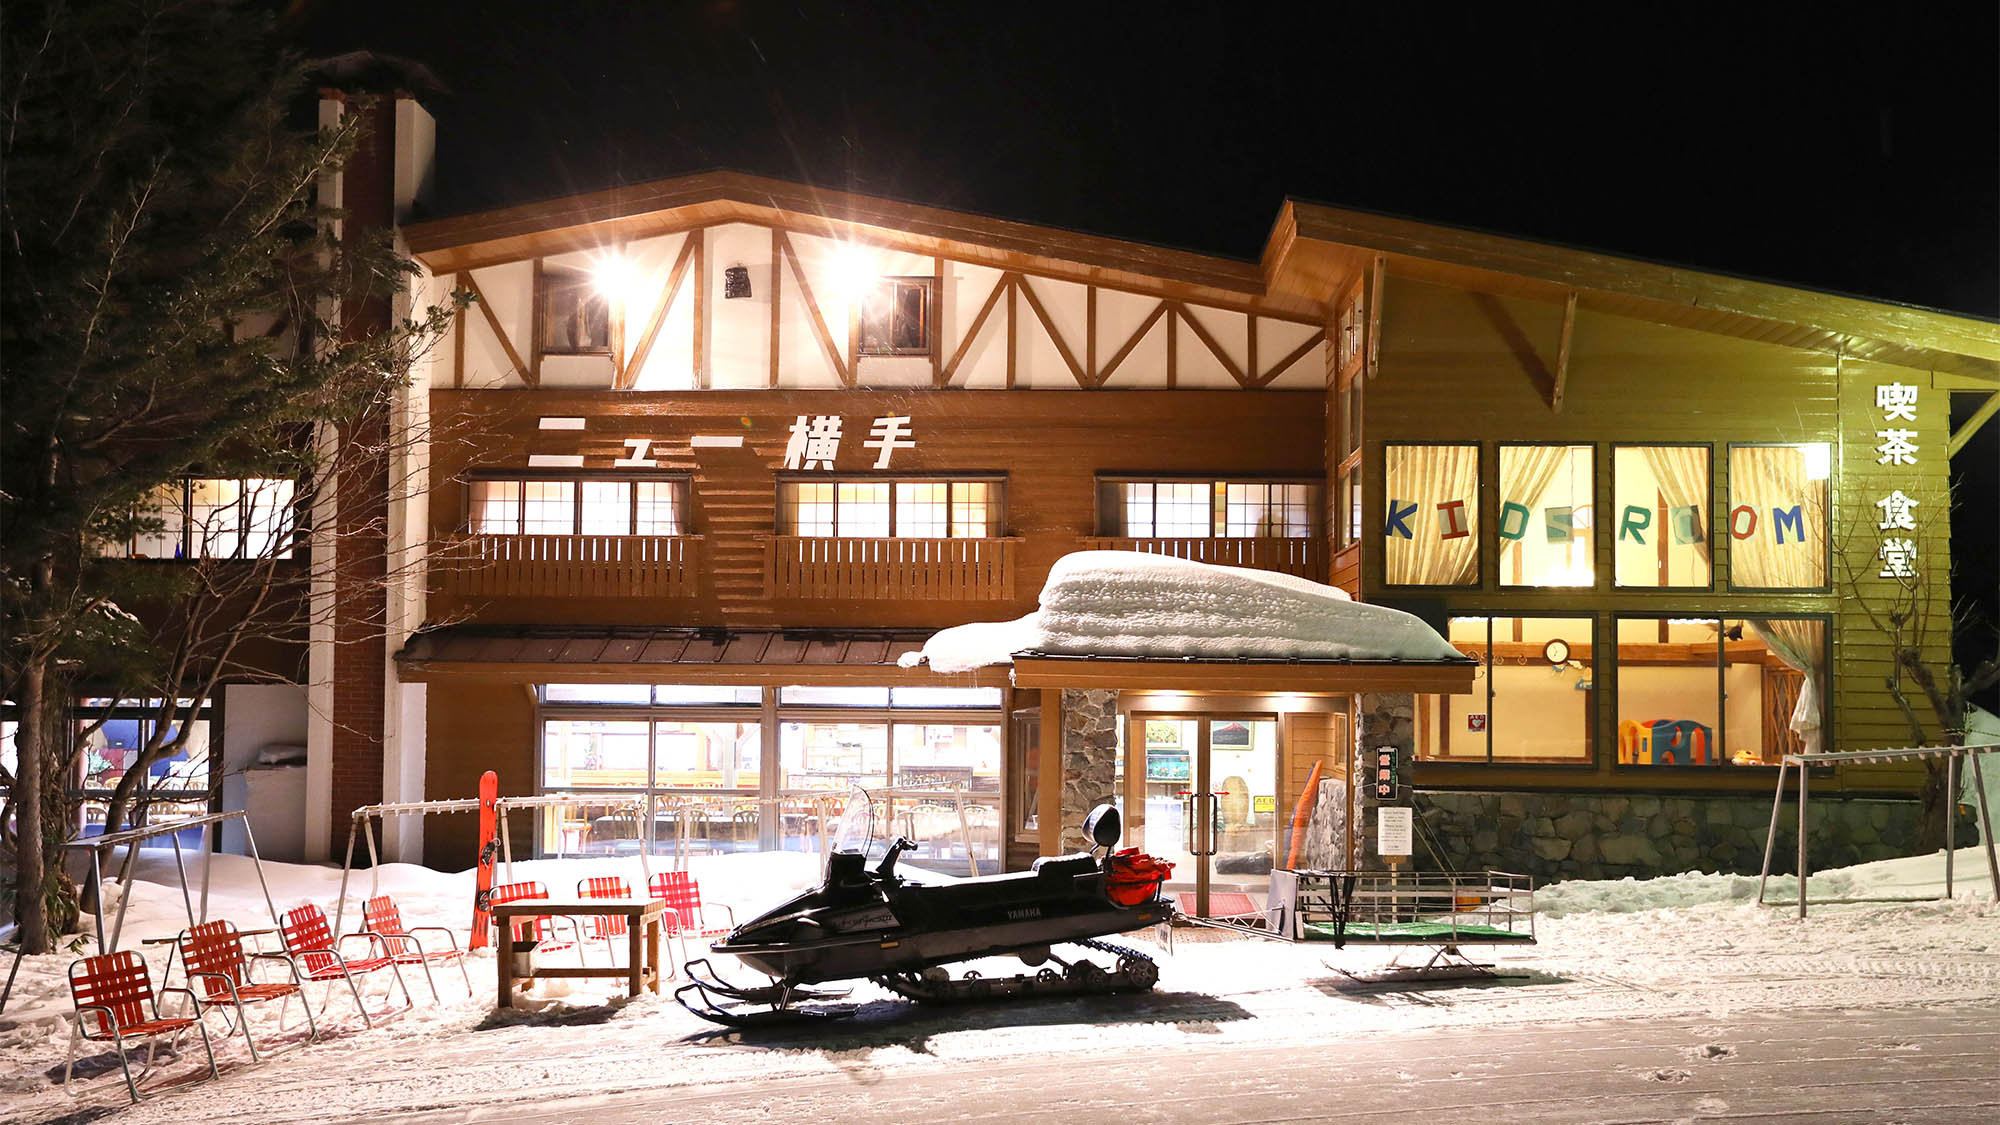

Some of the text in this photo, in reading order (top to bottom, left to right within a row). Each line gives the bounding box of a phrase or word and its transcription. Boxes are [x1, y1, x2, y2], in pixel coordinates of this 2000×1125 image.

[528, 415, 916, 471] ニュー横手
[1876, 382, 1920, 578] 喫茶 食堂
[1384, 499, 1806, 545] KIDS ROOM
[1007, 907, 1041, 920] YAMAHA
